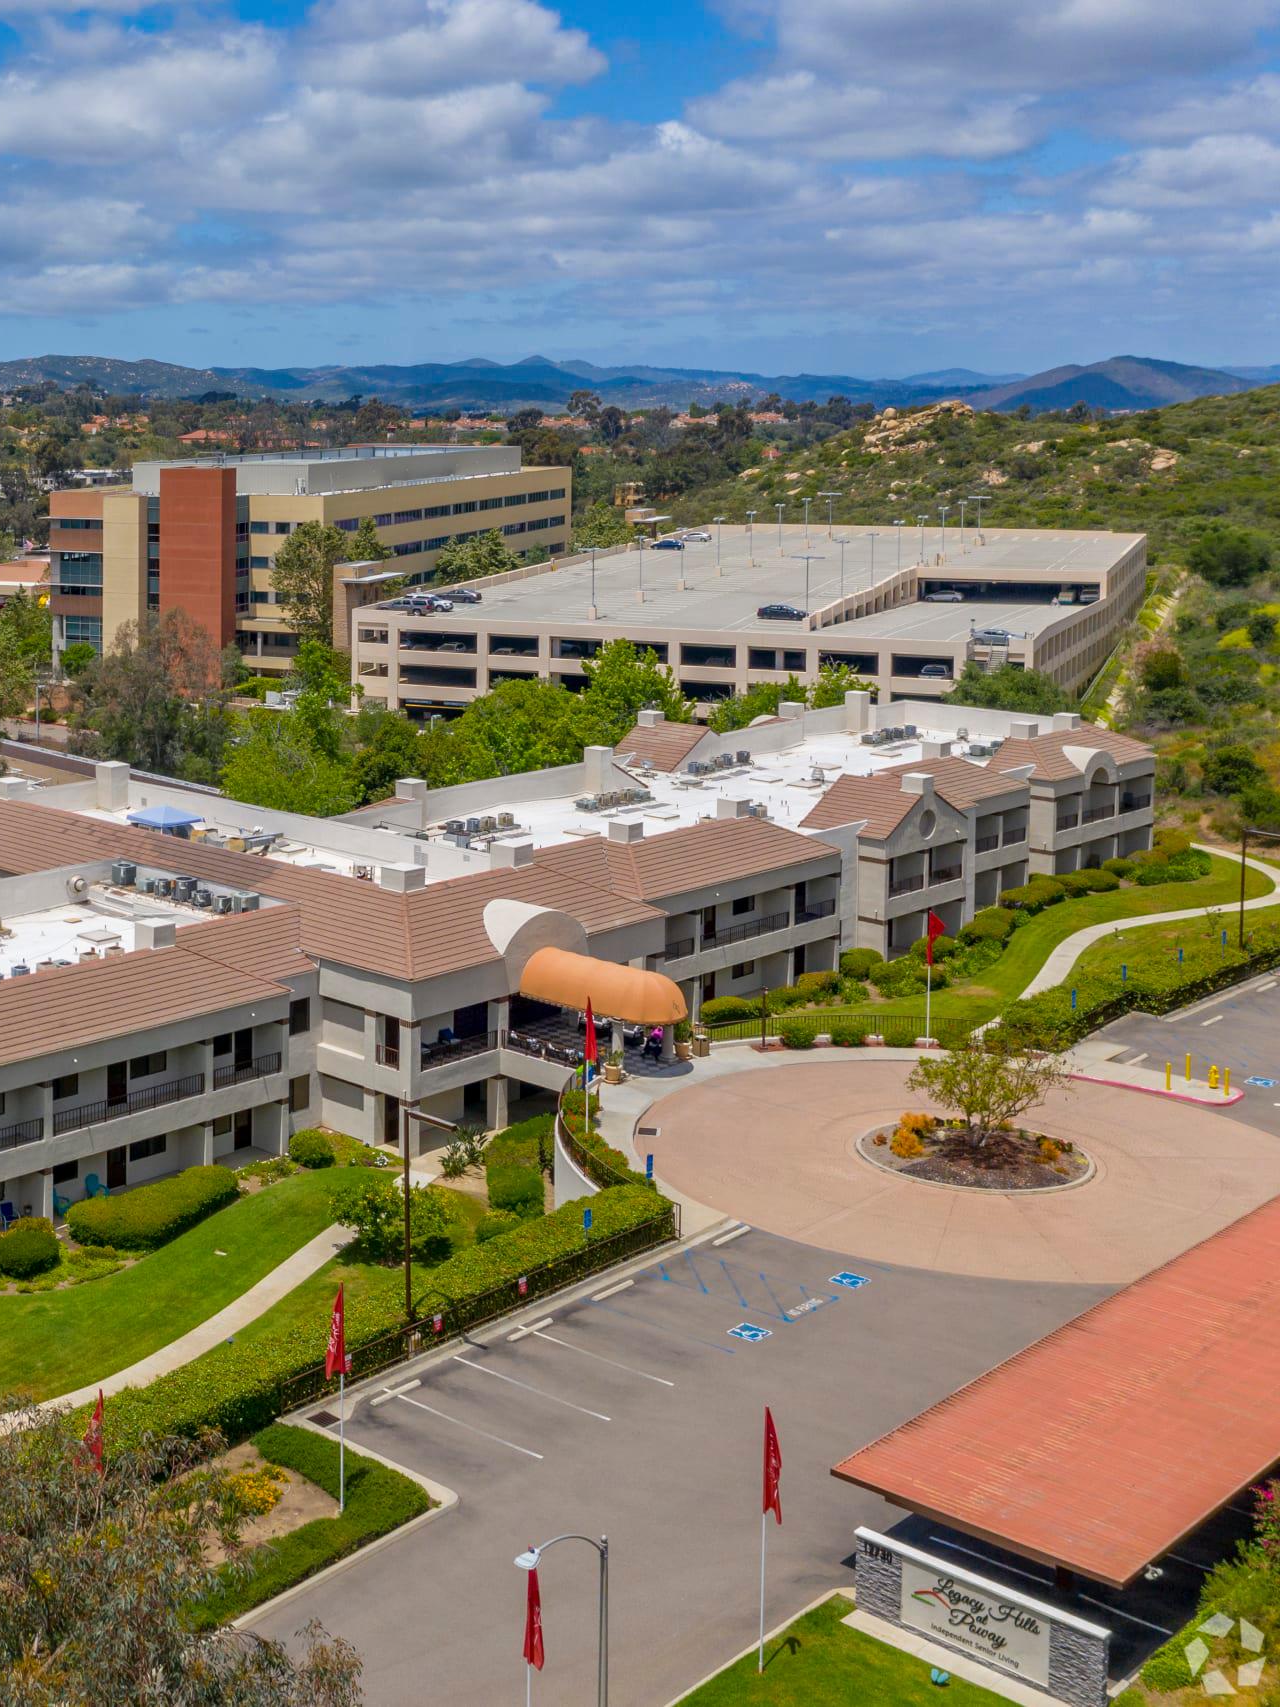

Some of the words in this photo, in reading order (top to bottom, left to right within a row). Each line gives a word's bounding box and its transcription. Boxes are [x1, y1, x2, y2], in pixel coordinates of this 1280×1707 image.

[932, 1578, 985, 1613] Legacy
[988, 1605, 1040, 1635] Hills
[975, 1615, 989, 1626] at
[930, 1623, 973, 1647] Independent
[974, 1642, 997, 1657] Senior
[998, 1652, 1020, 1668] Living
[948, 1608, 1007, 1649] Poway
